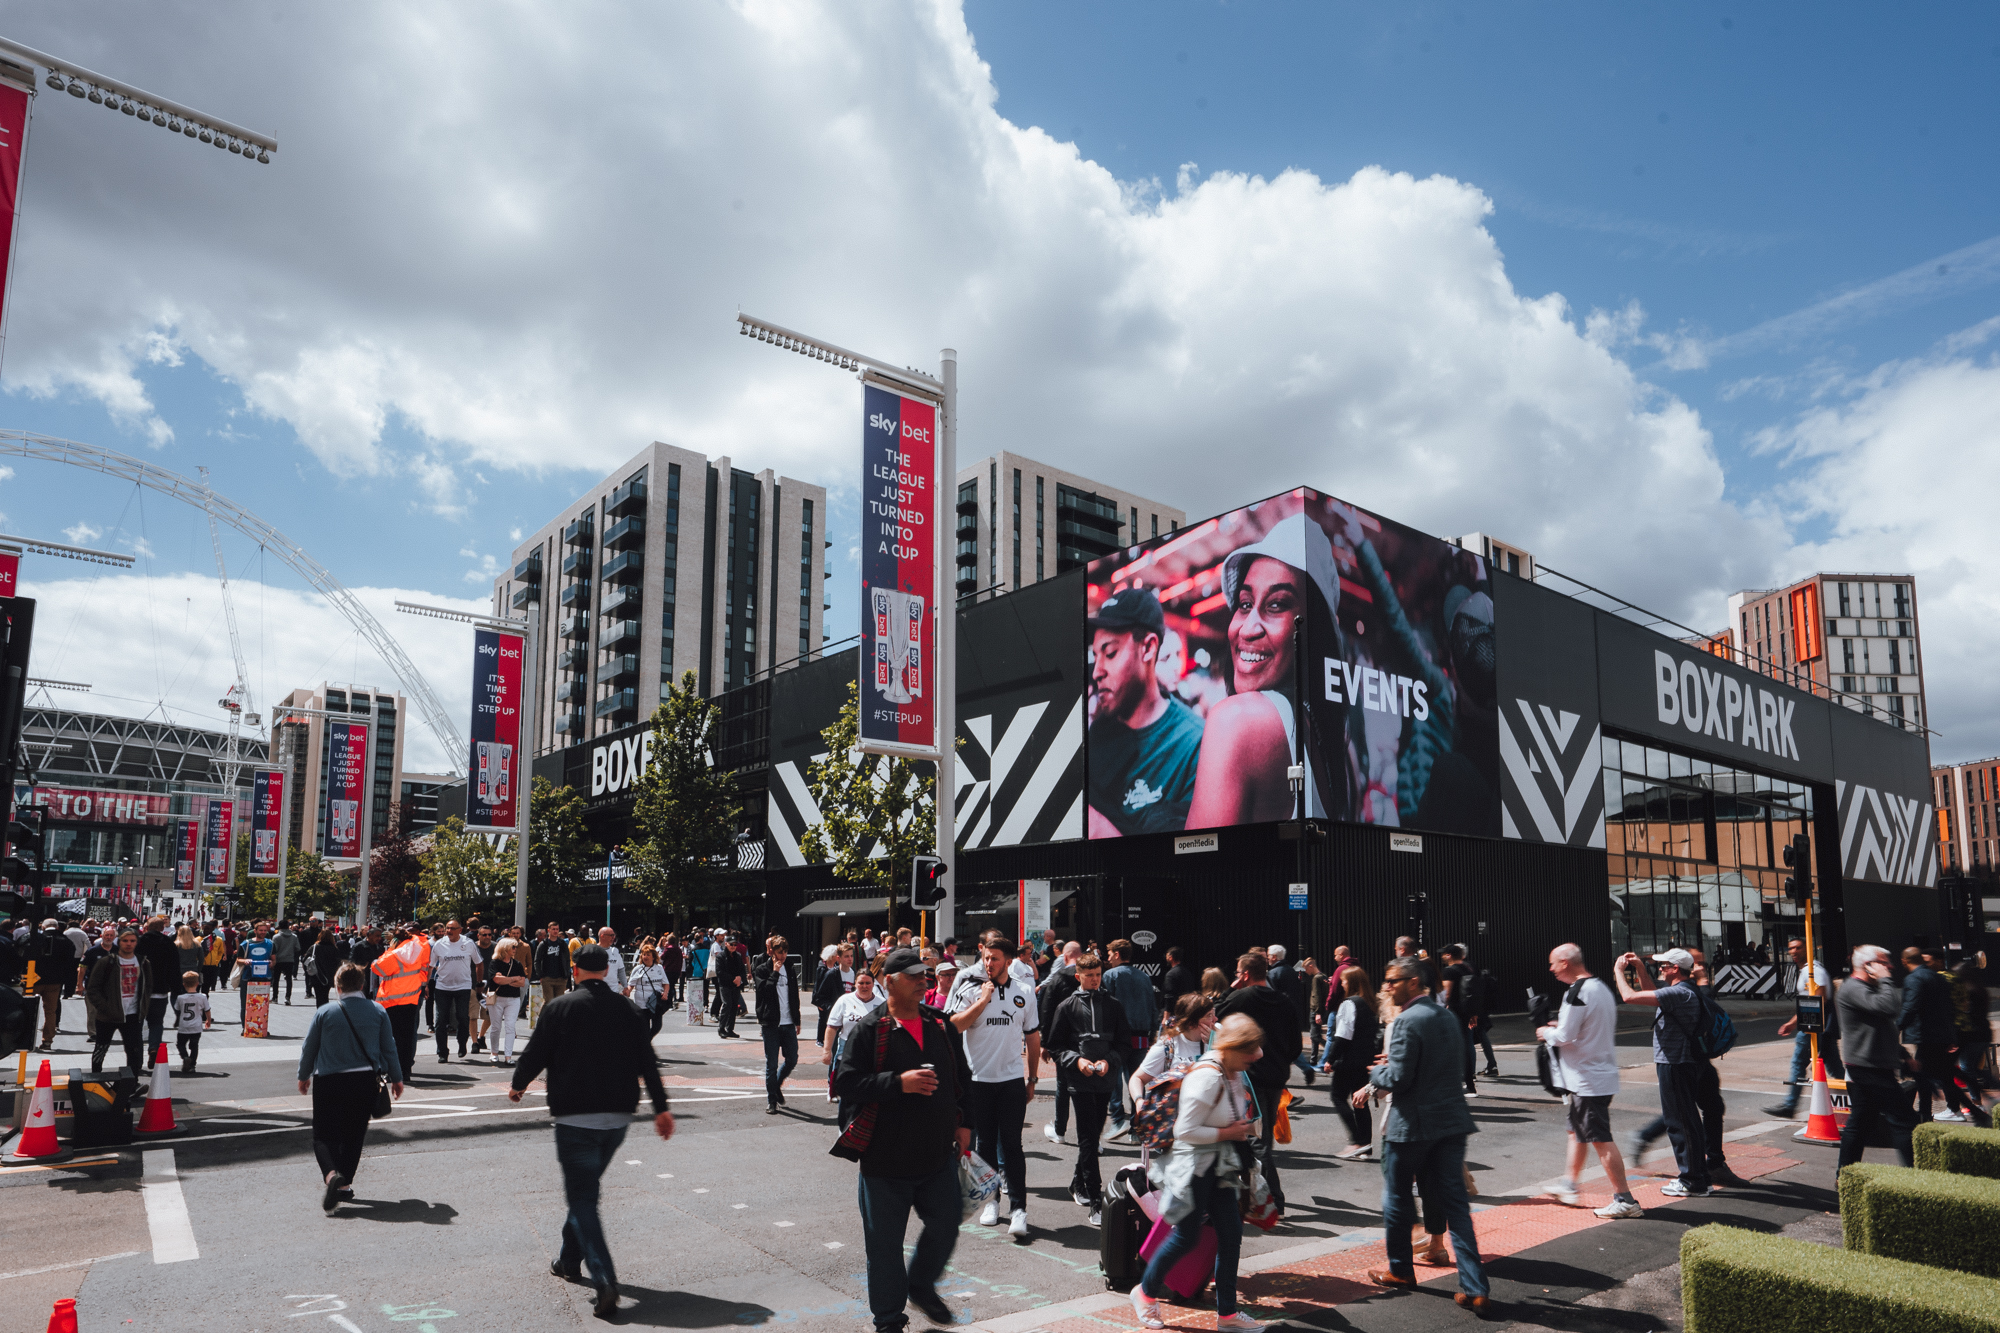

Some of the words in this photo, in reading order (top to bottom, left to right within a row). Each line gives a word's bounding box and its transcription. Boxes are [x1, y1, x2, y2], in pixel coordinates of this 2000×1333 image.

[870, 413, 896, 436] sky
[902, 421, 930, 443] bet
[885, 448, 910, 468] THE
[874, 464, 925, 490] LEAGUE
[881, 486, 914, 504] JUST
[870, 500, 924, 525] TURNED
[881, 522, 914, 542] INTO
[878, 541, 888, 554] A
[891, 544, 918, 561] CUP
[878, 616, 887, 635] bet
[910, 622, 918, 640] bet
[478, 644, 496, 657] sky
[500, 647, 519, 658] bet
[879, 644, 888, 661] sky
[910, 649, 918, 666] sky
[488, 674, 505, 684] IT'S
[879, 665, 887, 684] bet
[910, 669, 918, 687] bet
[486, 684, 507, 694] TIME
[1324, 657, 1428, 722] EVENTS
[490, 694, 502, 704] TO
[1654, 649, 1800, 761] BOXPARK
[478, 704, 500, 714] STEP
[502, 706, 514, 716] UP
[874, 709, 923, 726] #STEPUP
[334, 733, 348, 742] sky
[58, 794, 92, 816] TO
[100, 797, 146, 820] THE
[476, 808, 508, 817] #STEPUP
[1178, 838, 1214, 850] openMedia
[1393, 838, 1420, 848] openMedia
[183, 1002, 196, 1021] 5
[986, 1018, 1010, 1026] PUMA
